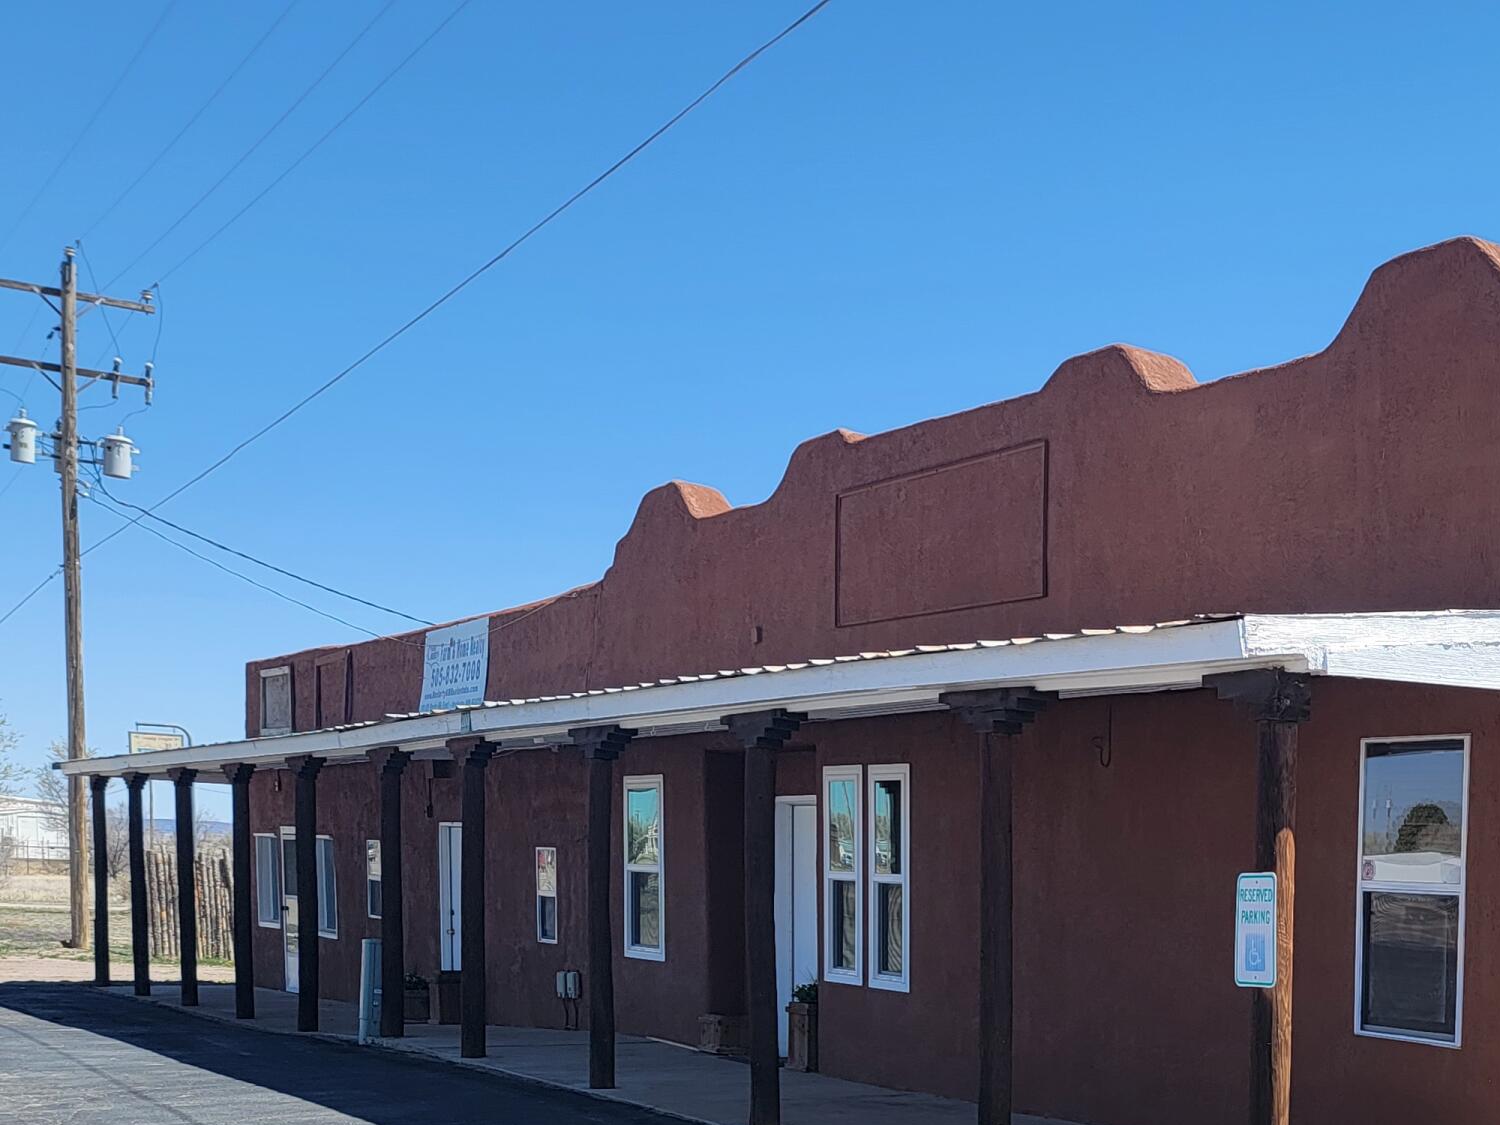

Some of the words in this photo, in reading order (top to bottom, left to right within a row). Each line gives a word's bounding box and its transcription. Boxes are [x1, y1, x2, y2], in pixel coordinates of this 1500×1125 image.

[431, 659, 481, 688] 505-832-7008
[1240, 888, 1273, 902] RESERVED
[1241, 910, 1270, 924] PARKING
